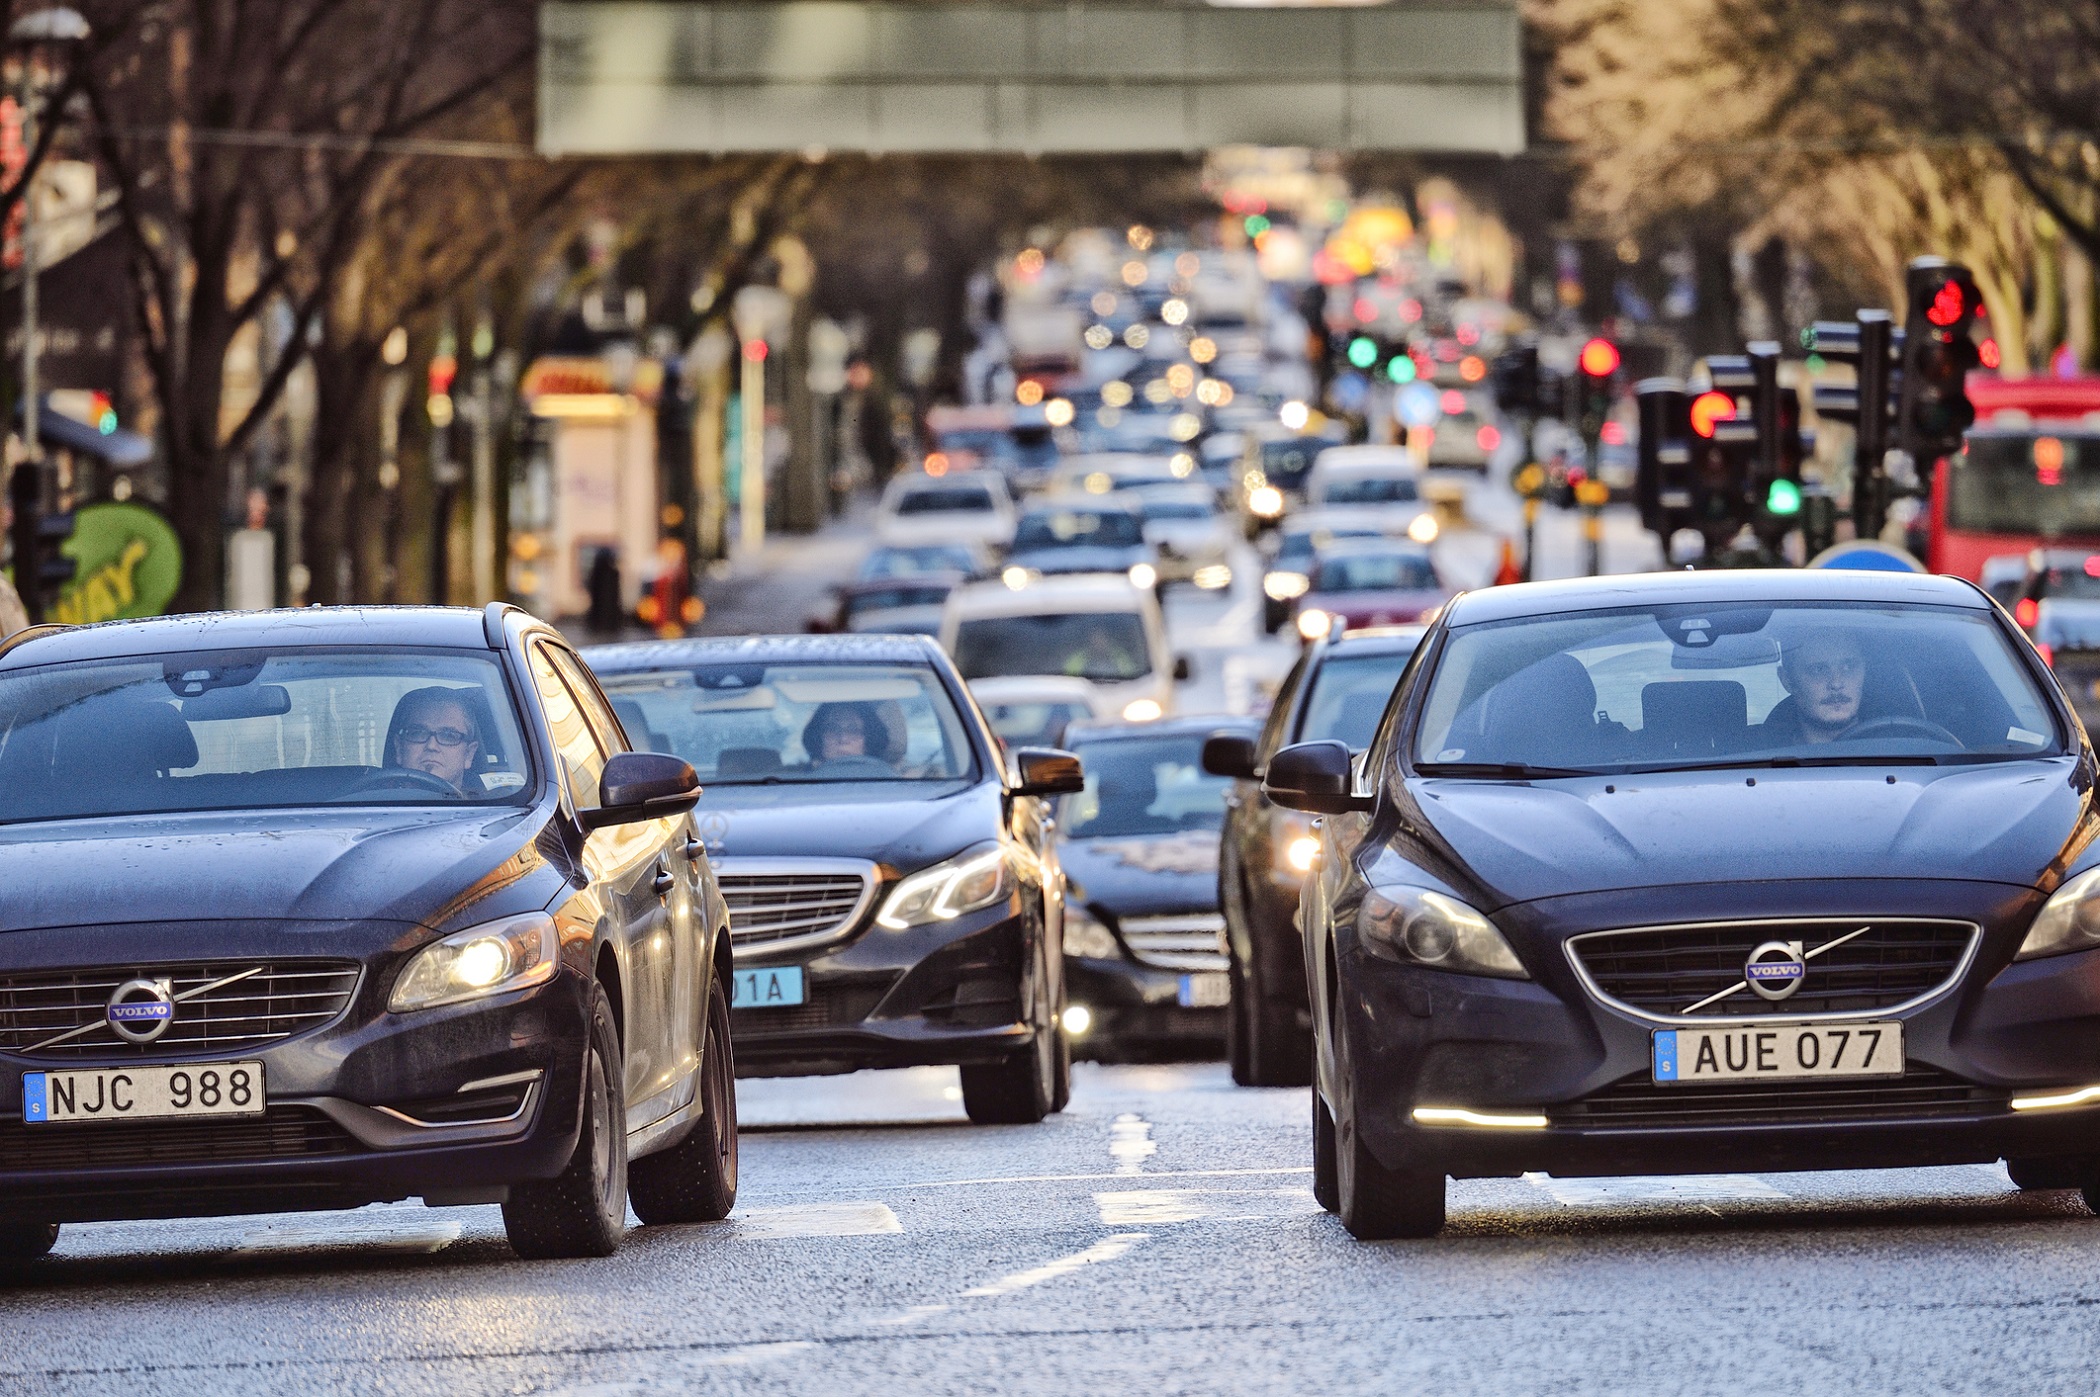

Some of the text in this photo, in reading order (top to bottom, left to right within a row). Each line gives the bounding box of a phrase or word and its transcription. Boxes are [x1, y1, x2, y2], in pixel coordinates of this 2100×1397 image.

[1750, 965, 1801, 976] VOLVO
[113, 1006, 168, 1017] VOLVO
[1694, 1030, 1882, 1073] AUE 077
[1662, 1060, 1671, 1072] S
[51, 1069, 252, 1115] NJC 988
[32, 1102, 40, 1113] S
